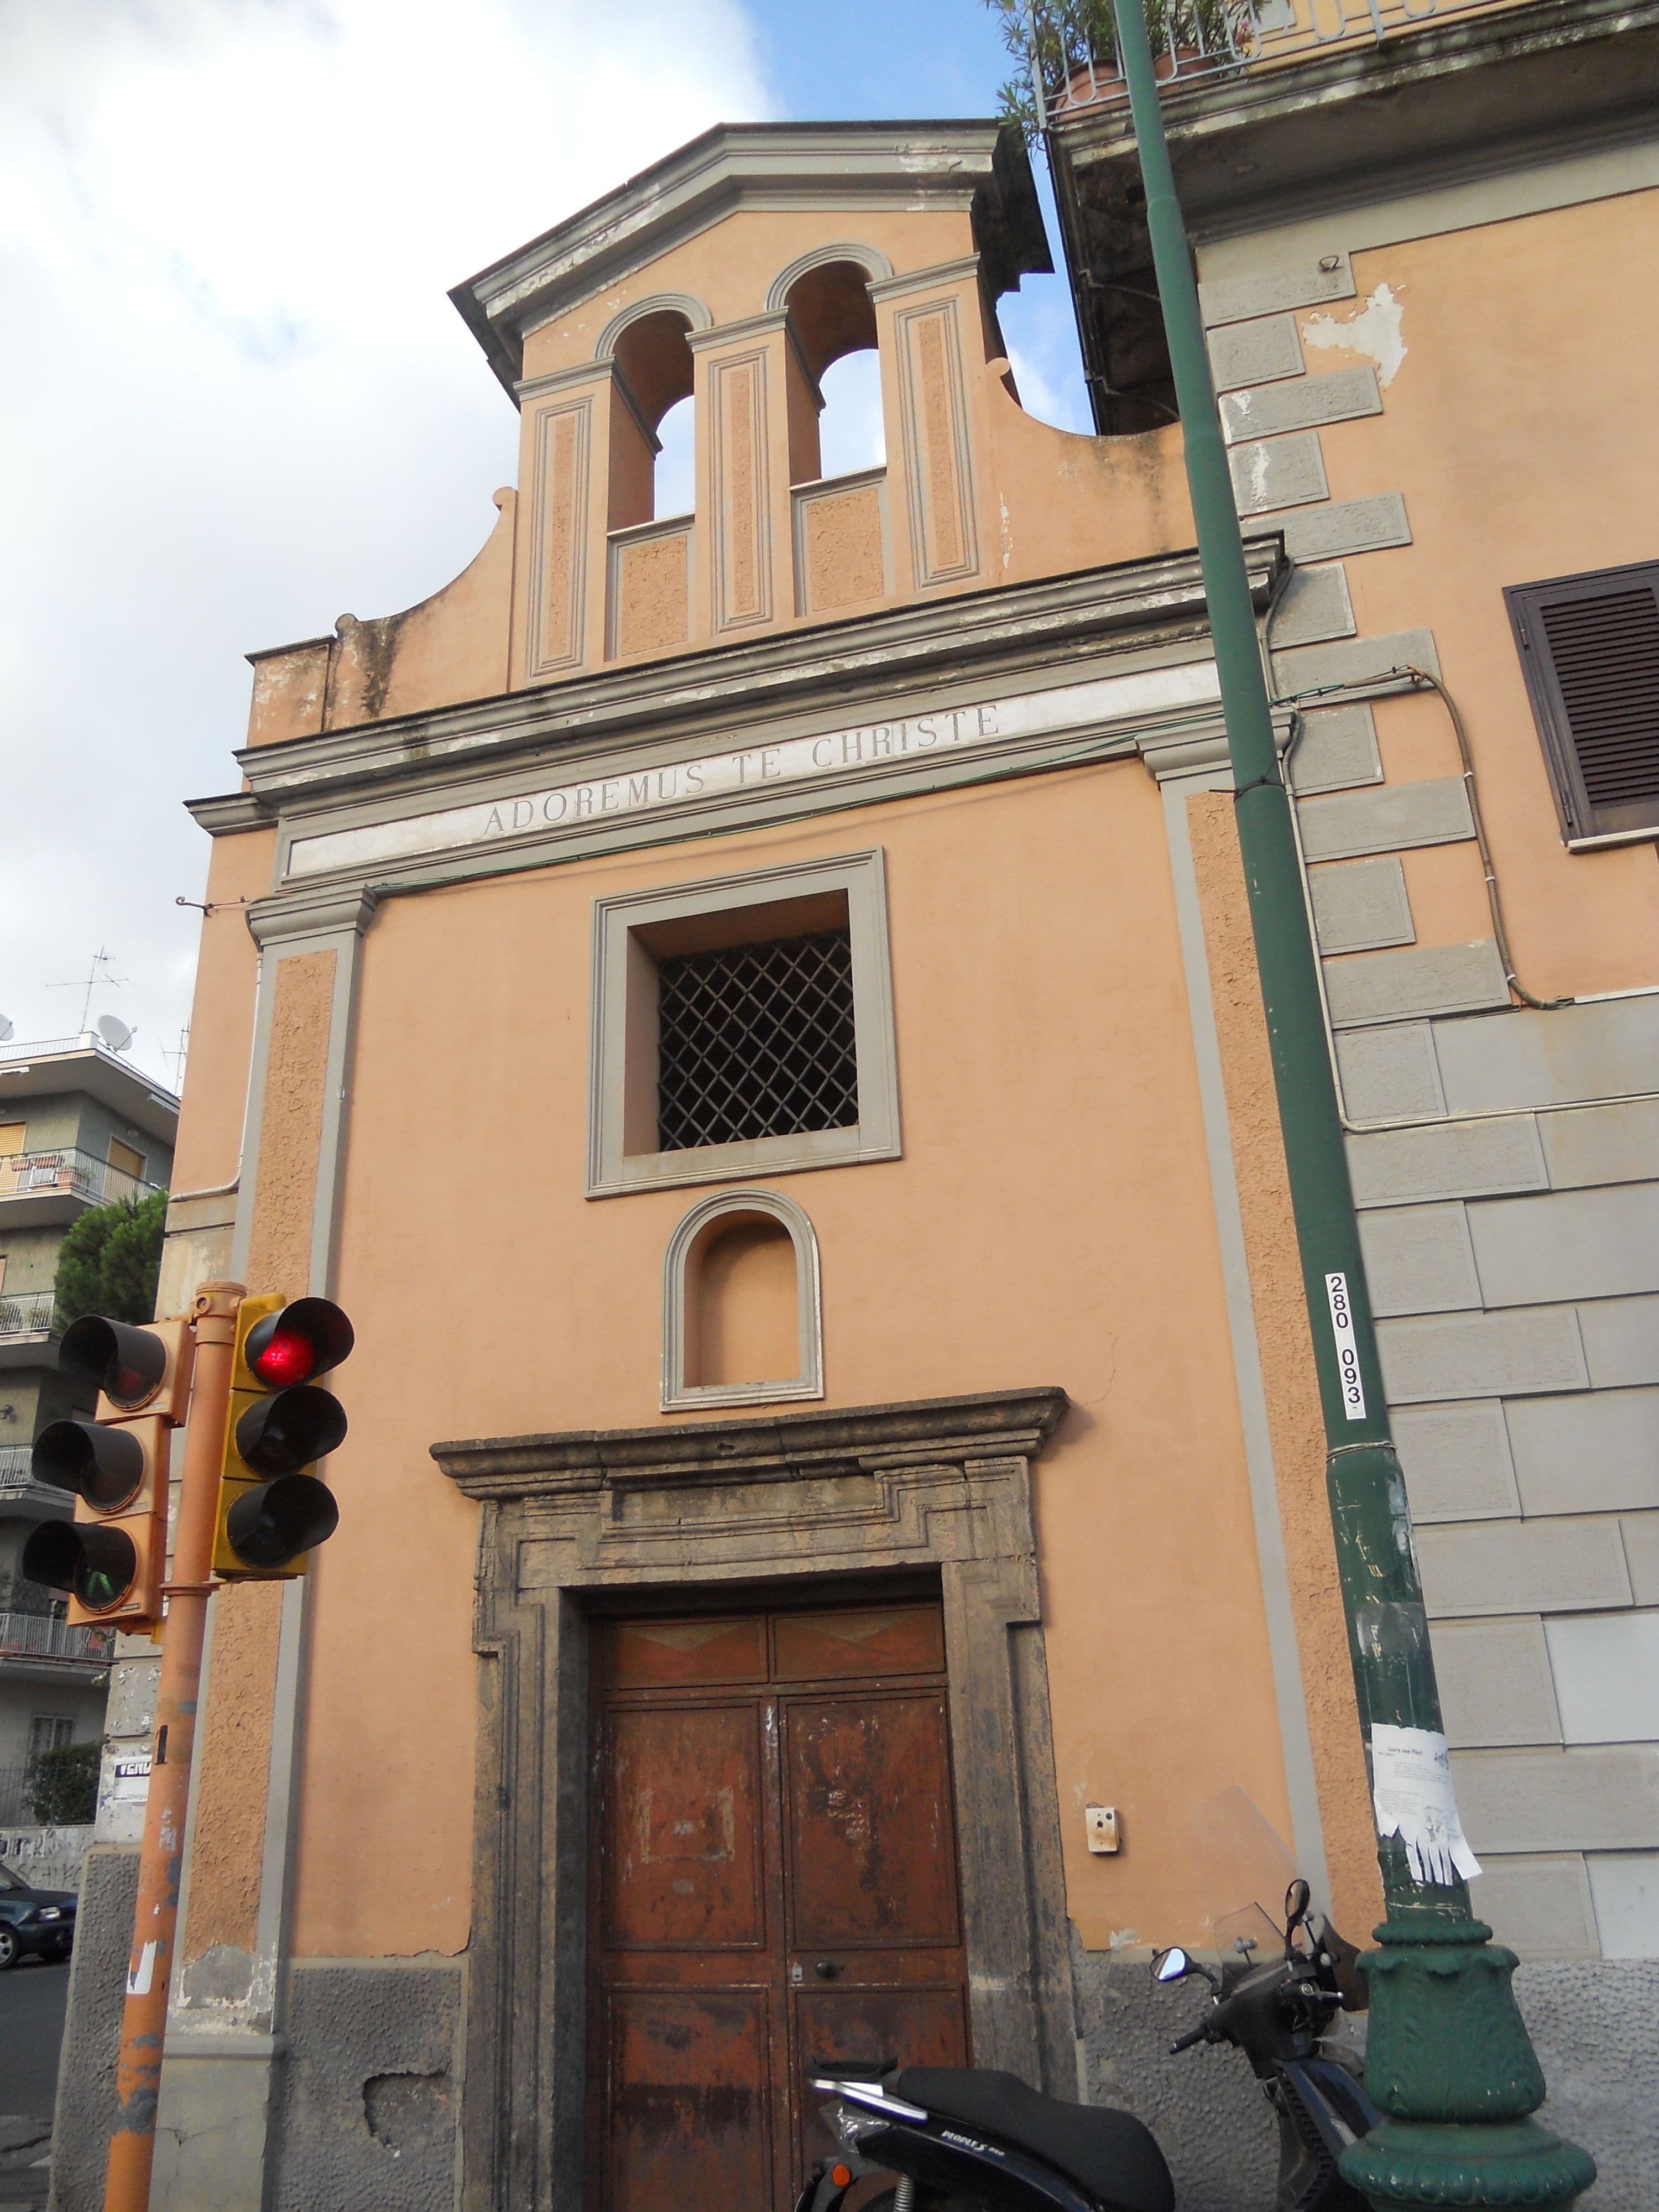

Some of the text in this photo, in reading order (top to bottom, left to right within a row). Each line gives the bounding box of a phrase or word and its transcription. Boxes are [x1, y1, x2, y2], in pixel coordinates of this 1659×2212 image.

[484, 705, 999, 834] ADOREMUS TE CHRISTE
[1331, 1276, 1360, 1403] 280 093
